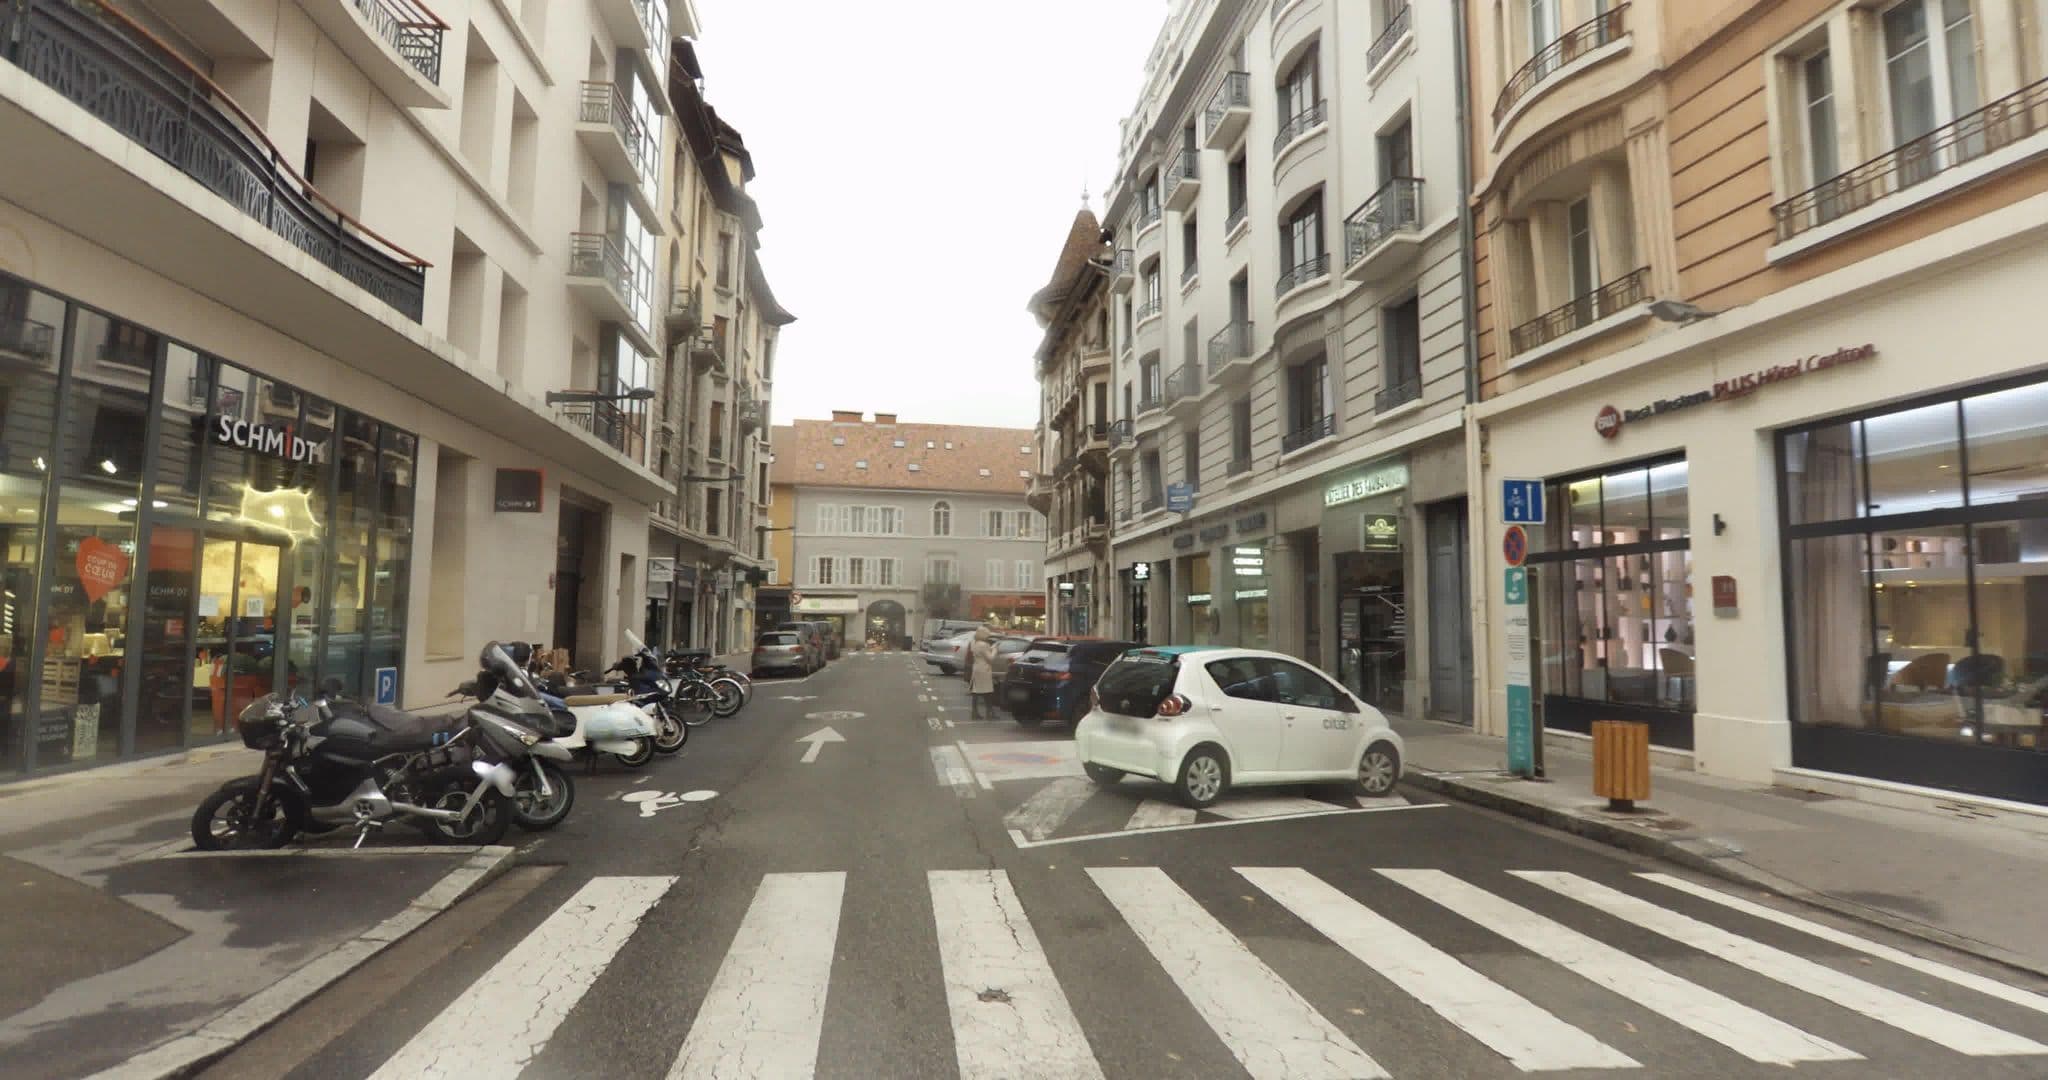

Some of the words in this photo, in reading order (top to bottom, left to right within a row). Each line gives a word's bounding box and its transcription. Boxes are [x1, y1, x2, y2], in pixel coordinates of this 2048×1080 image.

[1713, 373, 1755, 401] PLUS
[218, 414, 317, 465] SCHMIDT
[382, 676, 391, 698] P
